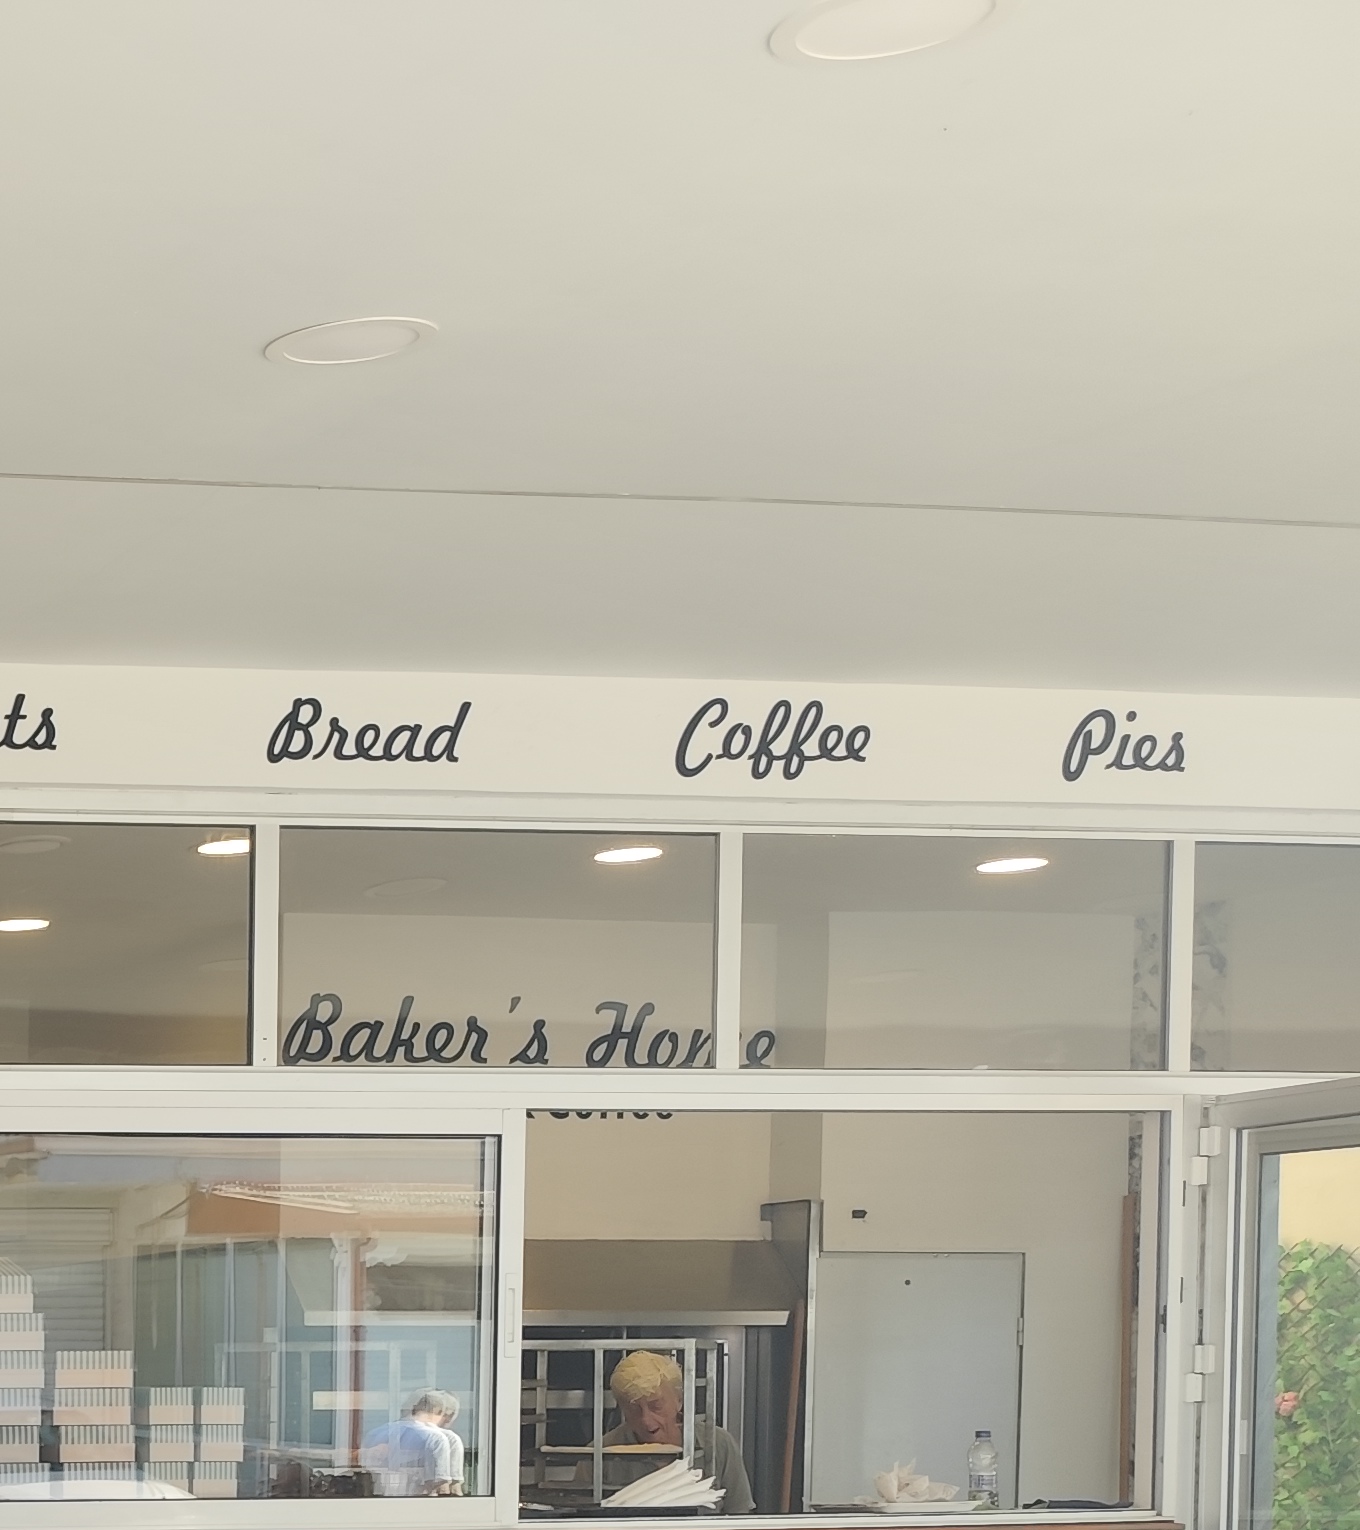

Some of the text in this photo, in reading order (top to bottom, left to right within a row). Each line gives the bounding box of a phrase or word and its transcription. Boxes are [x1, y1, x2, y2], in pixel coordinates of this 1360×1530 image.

[266, 696, 473, 765] Bread
[675, 697, 872, 781] Coffee
[1064, 709, 1185, 782] Pies
[283, 992, 550, 1066] Baker's
